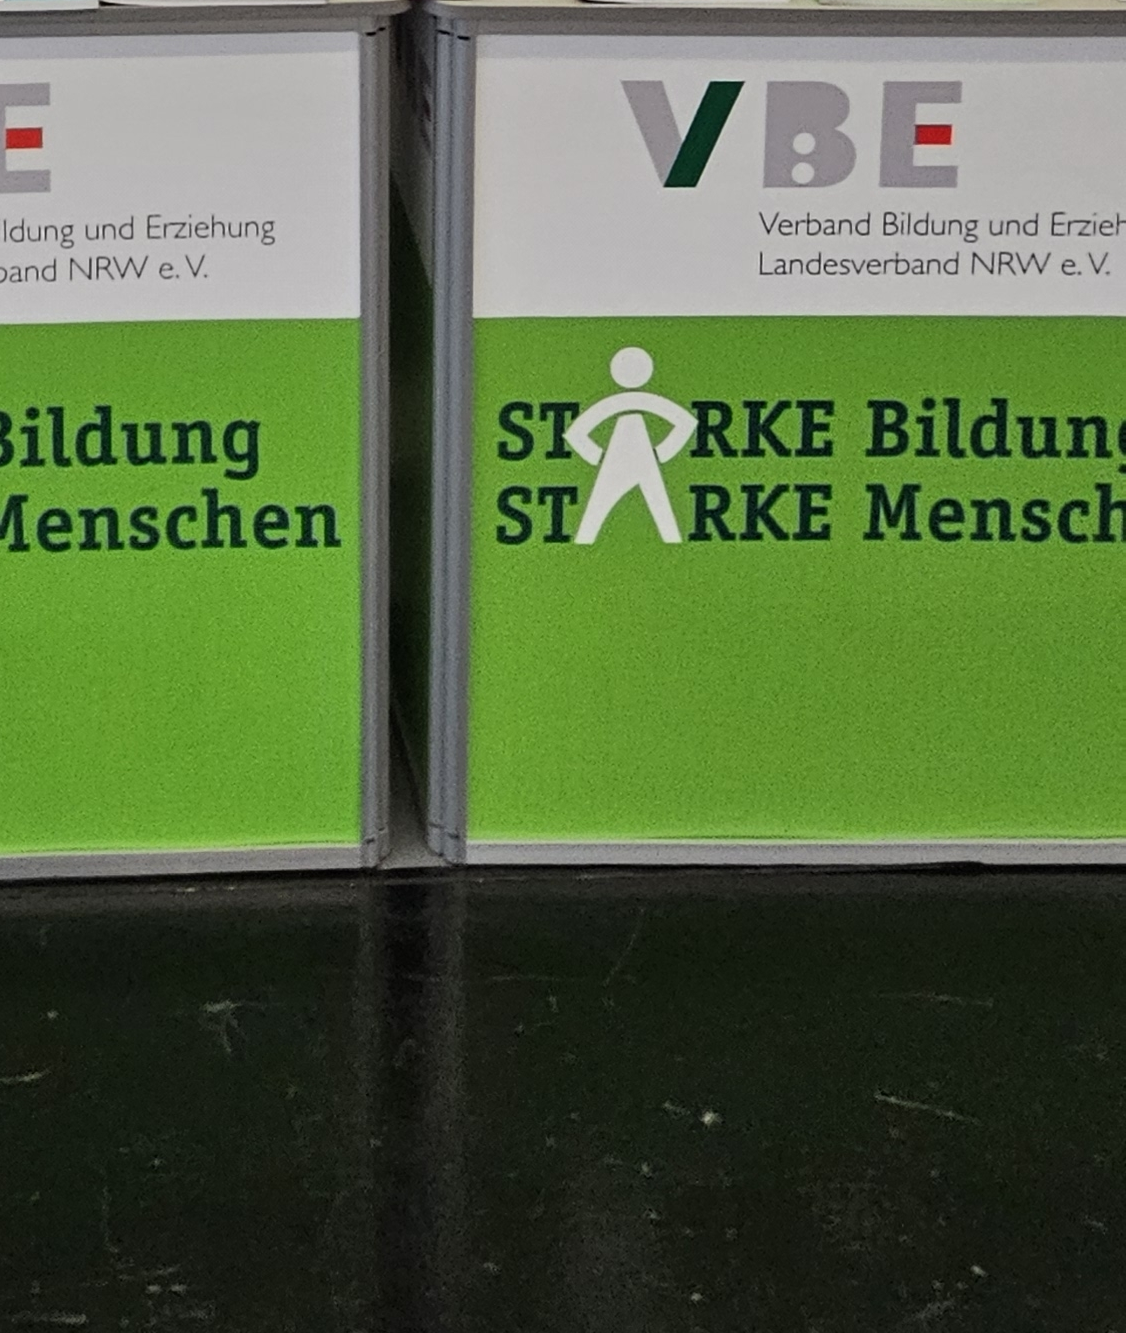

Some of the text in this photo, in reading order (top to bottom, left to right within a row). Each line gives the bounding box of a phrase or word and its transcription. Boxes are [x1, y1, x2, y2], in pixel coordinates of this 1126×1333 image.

[620, 80, 963, 188] VBE
[85, 215, 135, 242] und
[146, 212, 276, 246] Erziehung
[759, 211, 871, 237] Verband
[882, 211, 979, 244] Bildung
[989, 211, 1040, 237] und
[69, 255, 149, 282] NRW
[759, 251, 960, 277] Landesverband
[971, 251, 1052, 277] NRW
